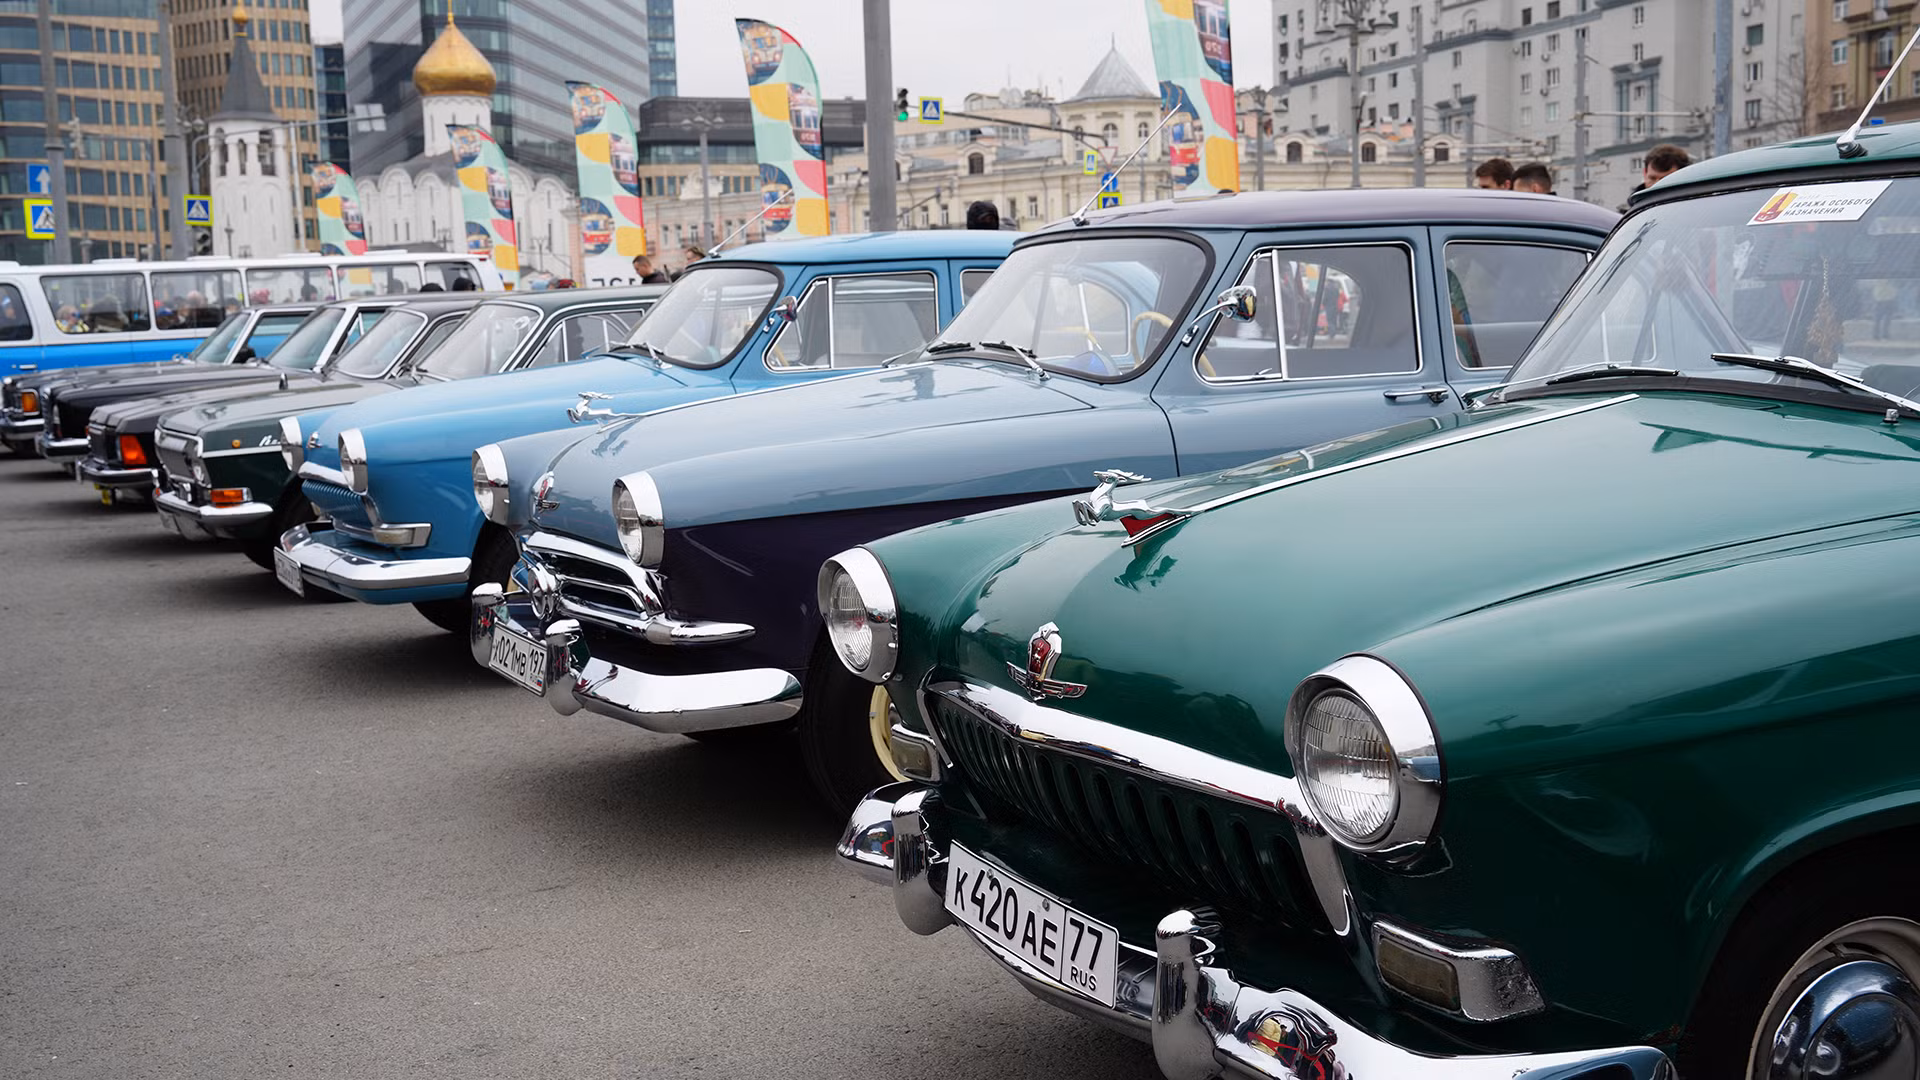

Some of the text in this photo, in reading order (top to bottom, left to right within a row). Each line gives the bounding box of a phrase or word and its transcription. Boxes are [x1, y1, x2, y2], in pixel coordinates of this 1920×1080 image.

[1783, 207, 1845, 216] НАЗНАЧЕНИЯ
[1790, 200, 1826, 208] ГАРАЖА
[530, 648, 545, 674] 197
[1069, 917, 1103, 971] 77
[1070, 966, 1097, 991] RUS
